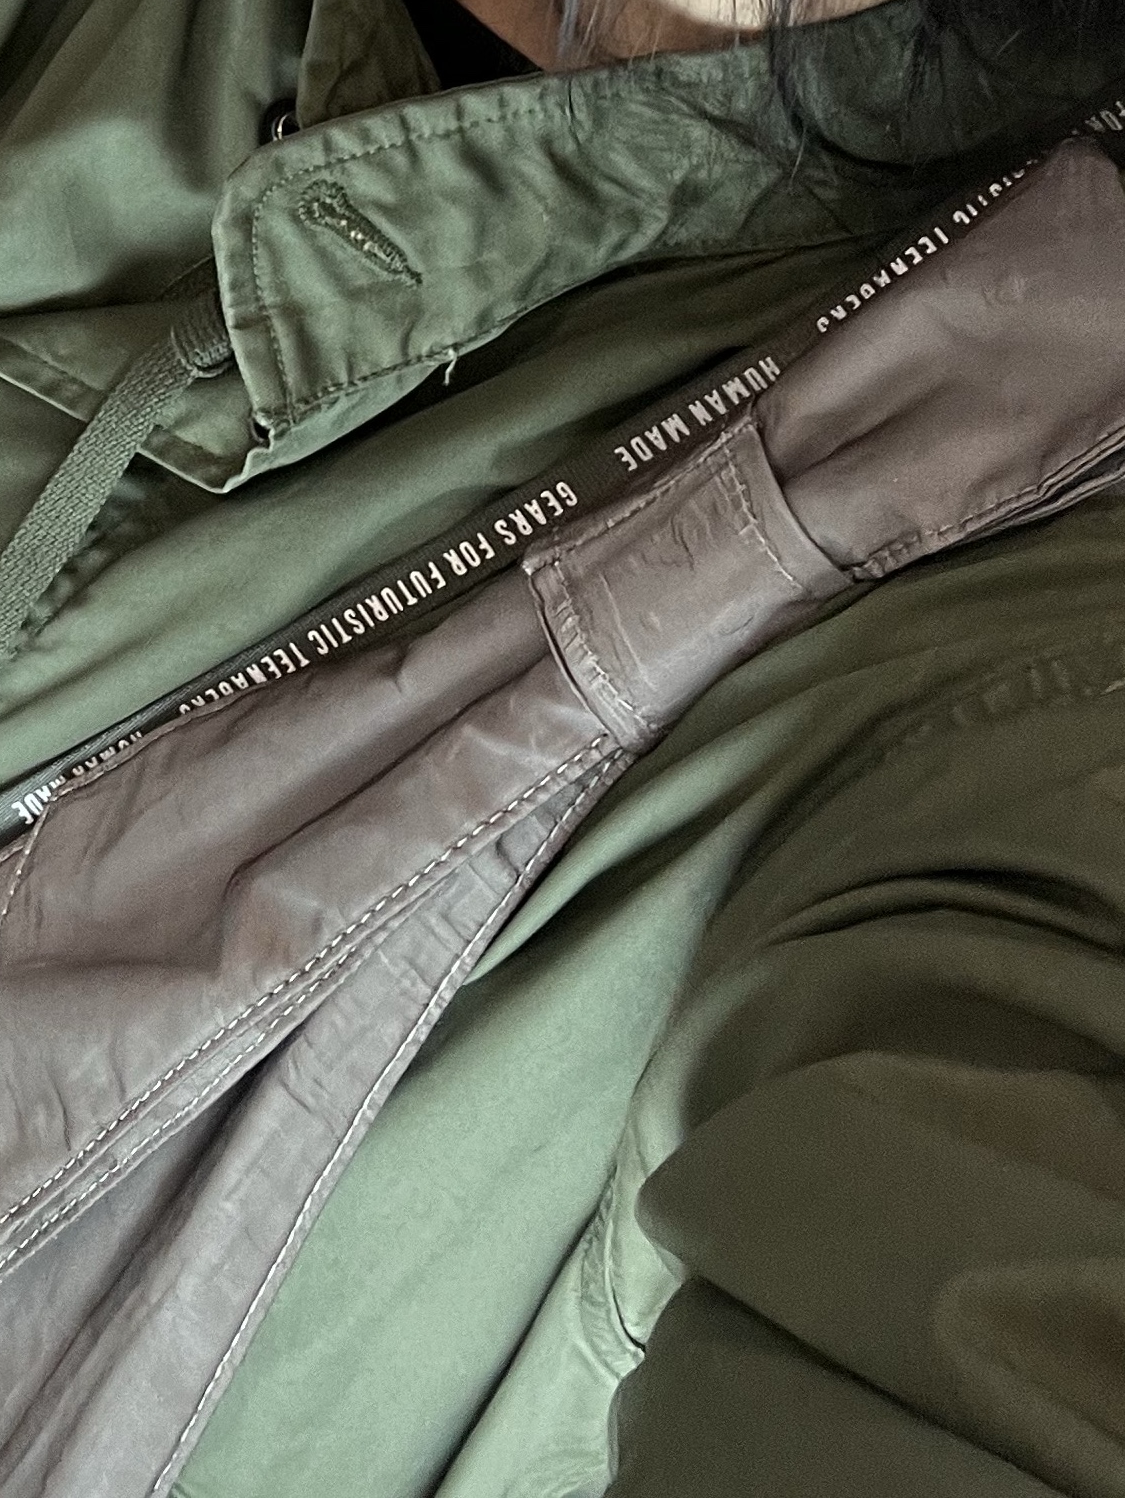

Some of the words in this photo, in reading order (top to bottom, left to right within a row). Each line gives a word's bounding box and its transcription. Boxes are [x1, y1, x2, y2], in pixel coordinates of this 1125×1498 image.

[687, 356, 781, 427] HUMAN
[613, 412, 691, 473] MADE
[493, 481, 579, 546] GEARS
[442, 531, 496, 577] FOR
[306, 560, 447, 657] FUTURISTIC
